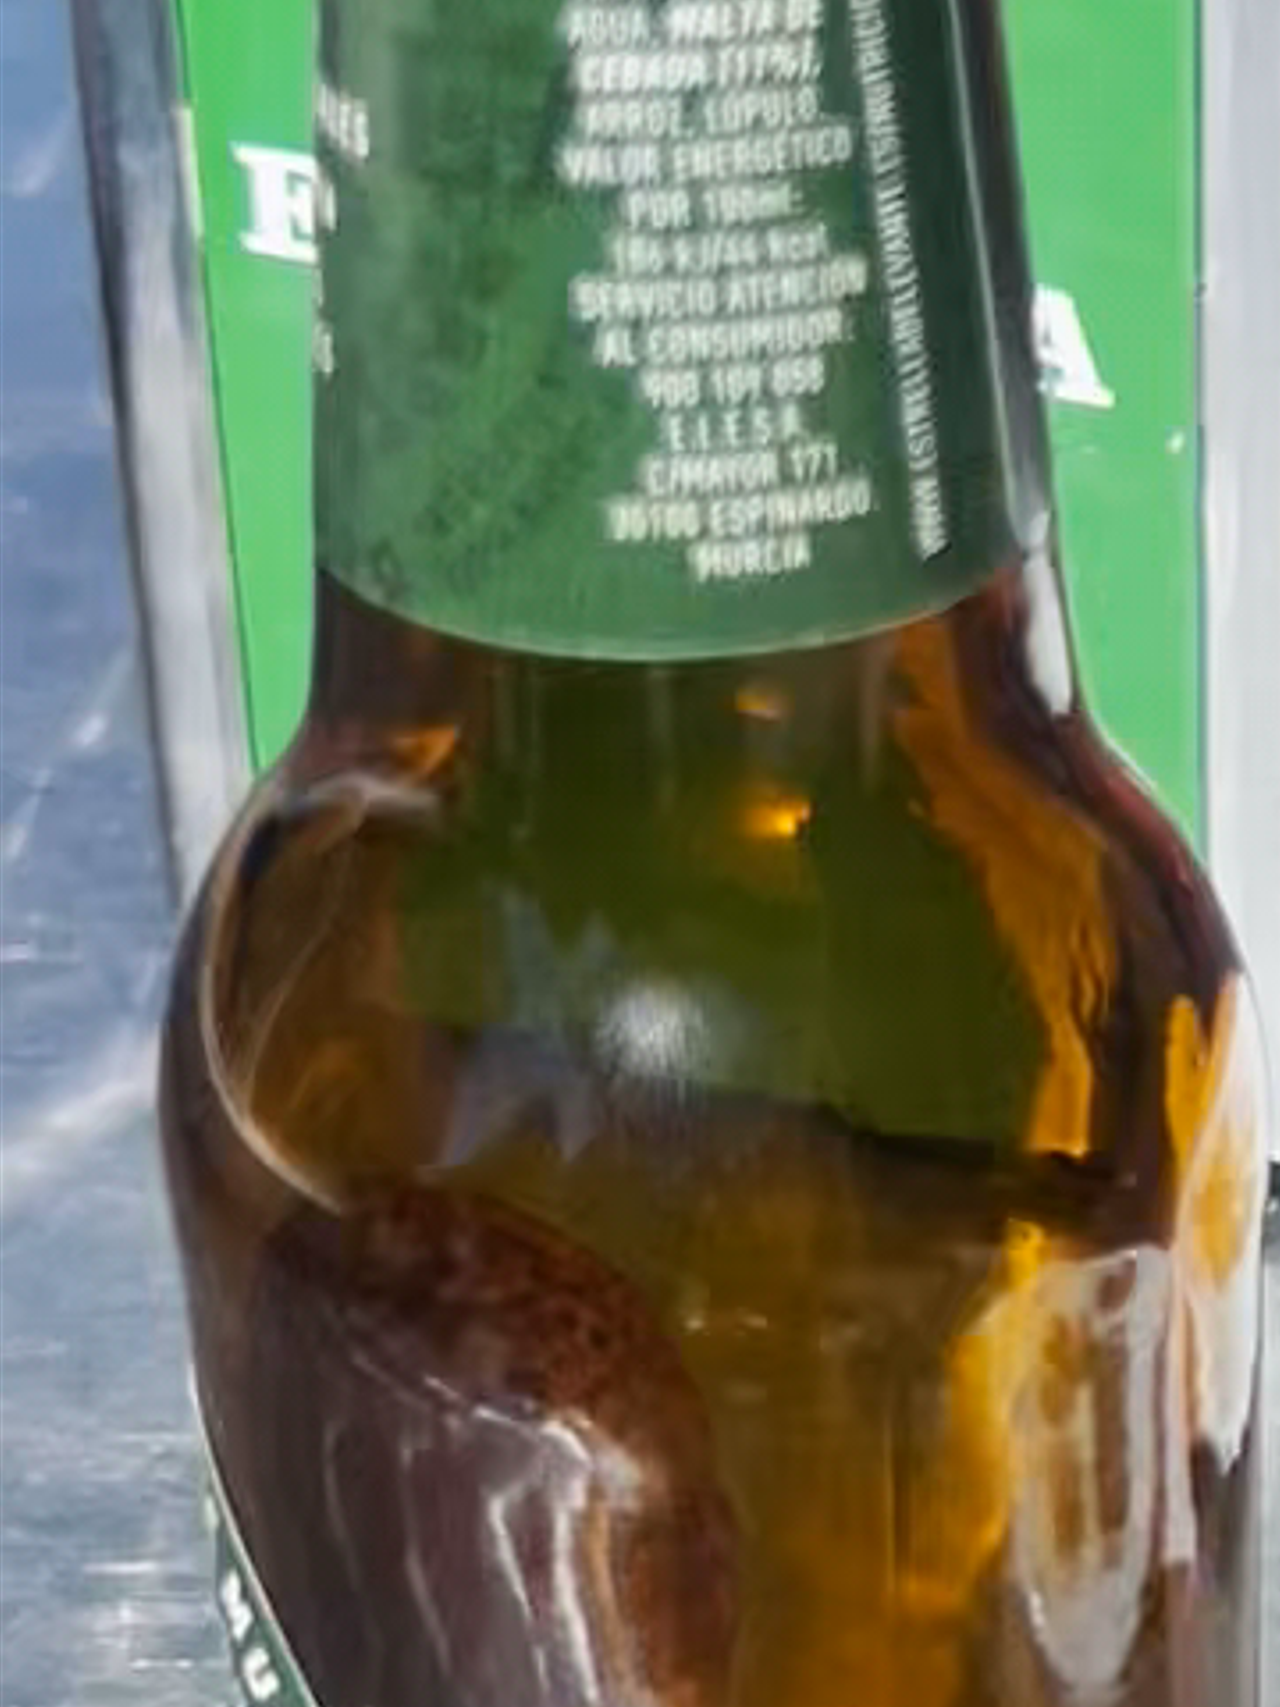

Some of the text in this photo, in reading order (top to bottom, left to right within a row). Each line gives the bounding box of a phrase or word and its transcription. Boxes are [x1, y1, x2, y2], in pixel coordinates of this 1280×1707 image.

[577, 51, 708, 95] CEBADA
[560, 143, 660, 186] VALOR
[625, 190, 690, 230] POR
[572, 276, 718, 323] SERVICIO
[596, 327, 638, 368] AL
[686, 535, 812, 582] MURCIA
